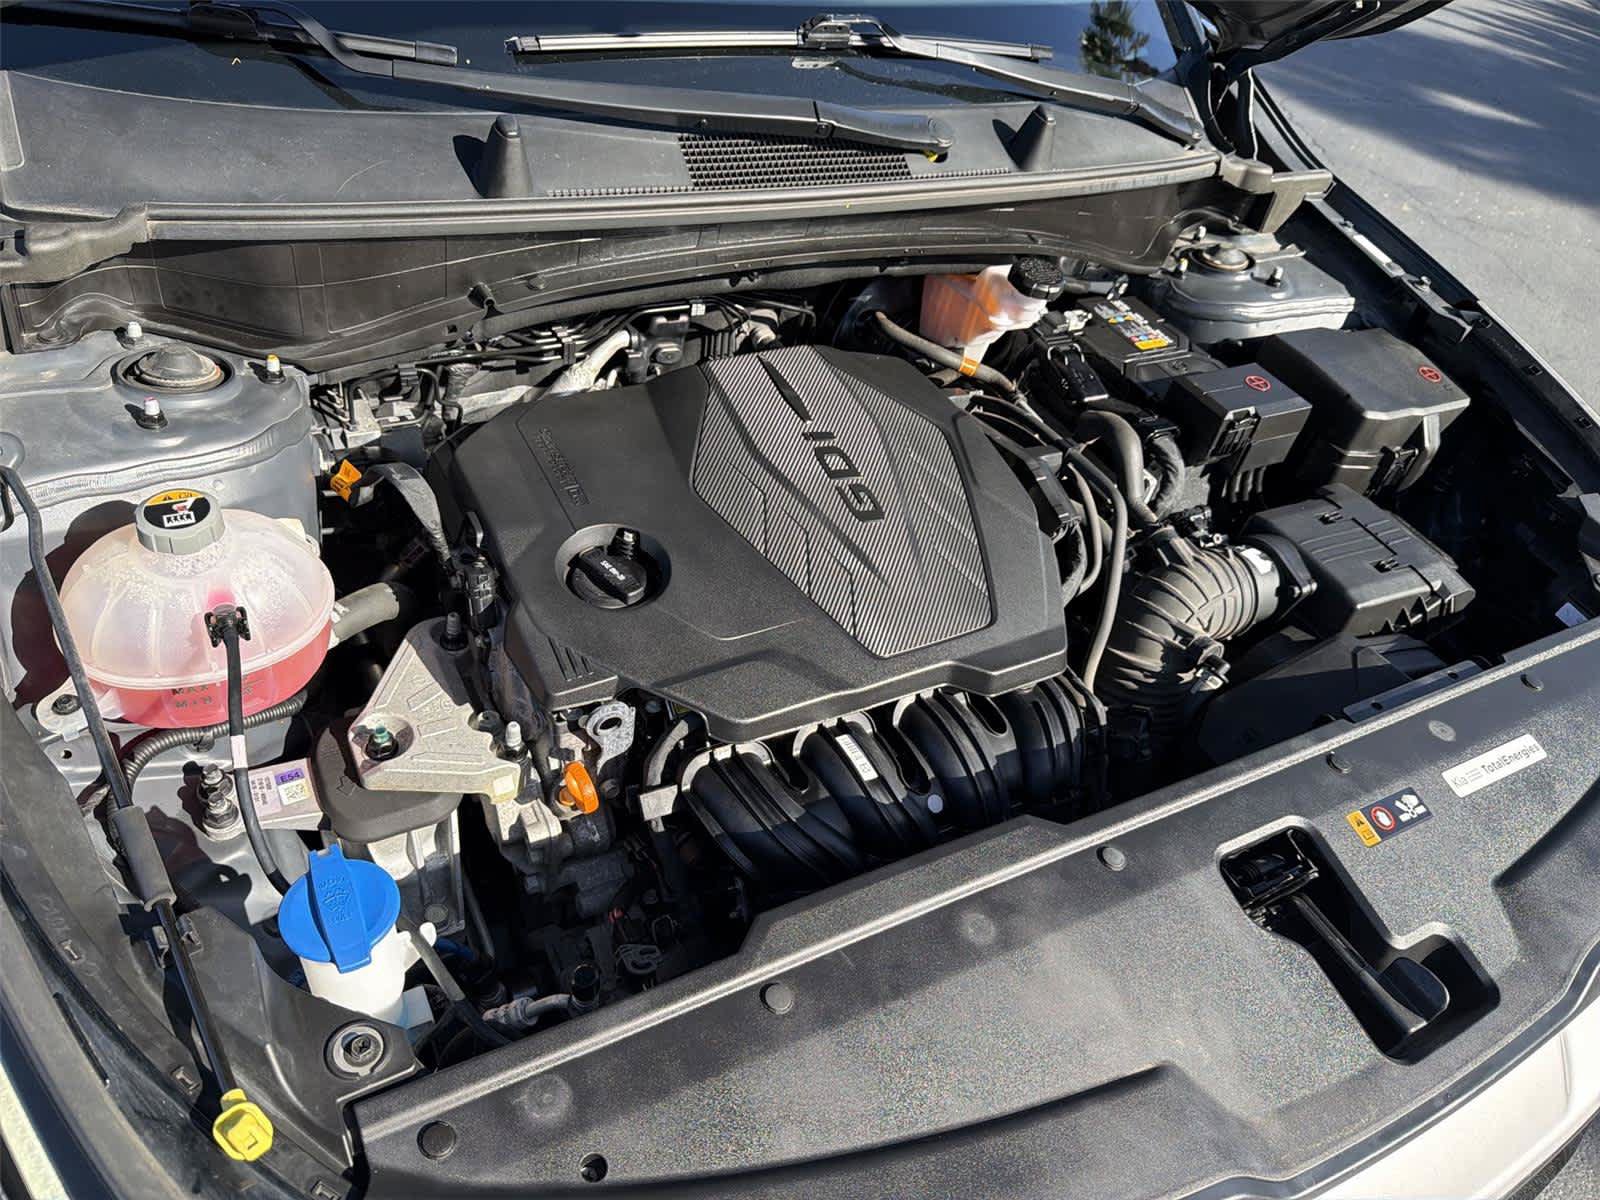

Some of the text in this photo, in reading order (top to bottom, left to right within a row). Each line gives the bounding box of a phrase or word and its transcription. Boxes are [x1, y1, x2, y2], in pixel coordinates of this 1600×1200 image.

[801, 431, 886, 522] GDI
[1480, 743, 1541, 775] TotalEnergies
[279, 771, 302, 783] E54
